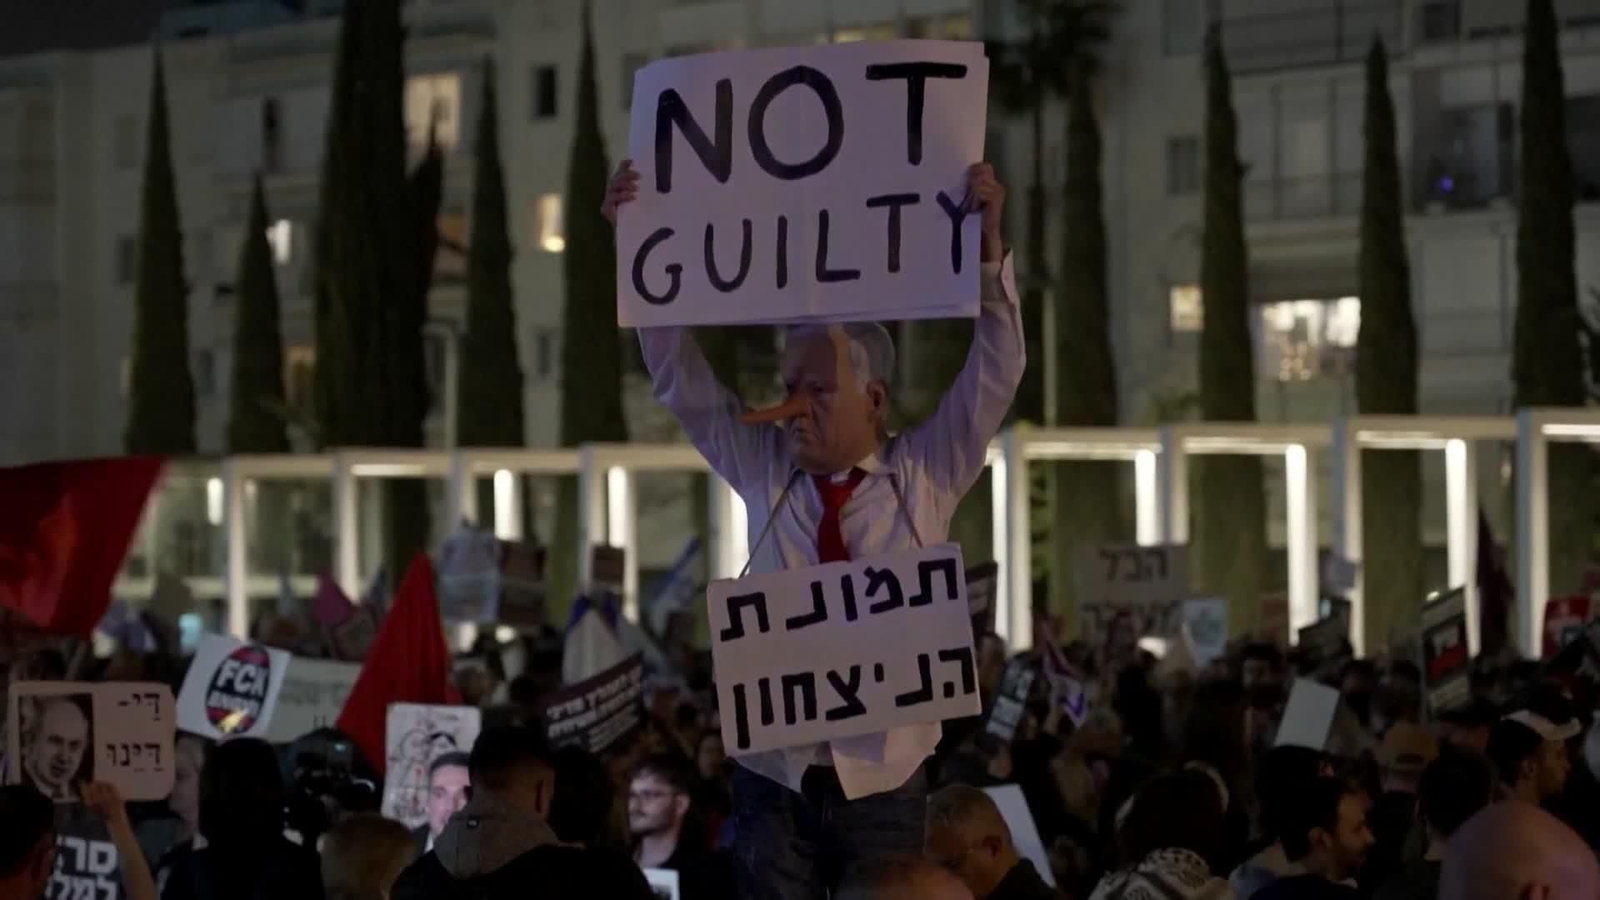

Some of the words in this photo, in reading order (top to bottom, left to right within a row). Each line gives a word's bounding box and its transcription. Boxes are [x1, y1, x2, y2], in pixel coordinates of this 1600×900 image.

[655, 62, 967, 193] NOT
[632, 190, 970, 305] GUILTY
[721, 558, 958, 642] תמונת
[214, 658, 270, 698] FCK
[733, 647, 975, 749] הניצחון
